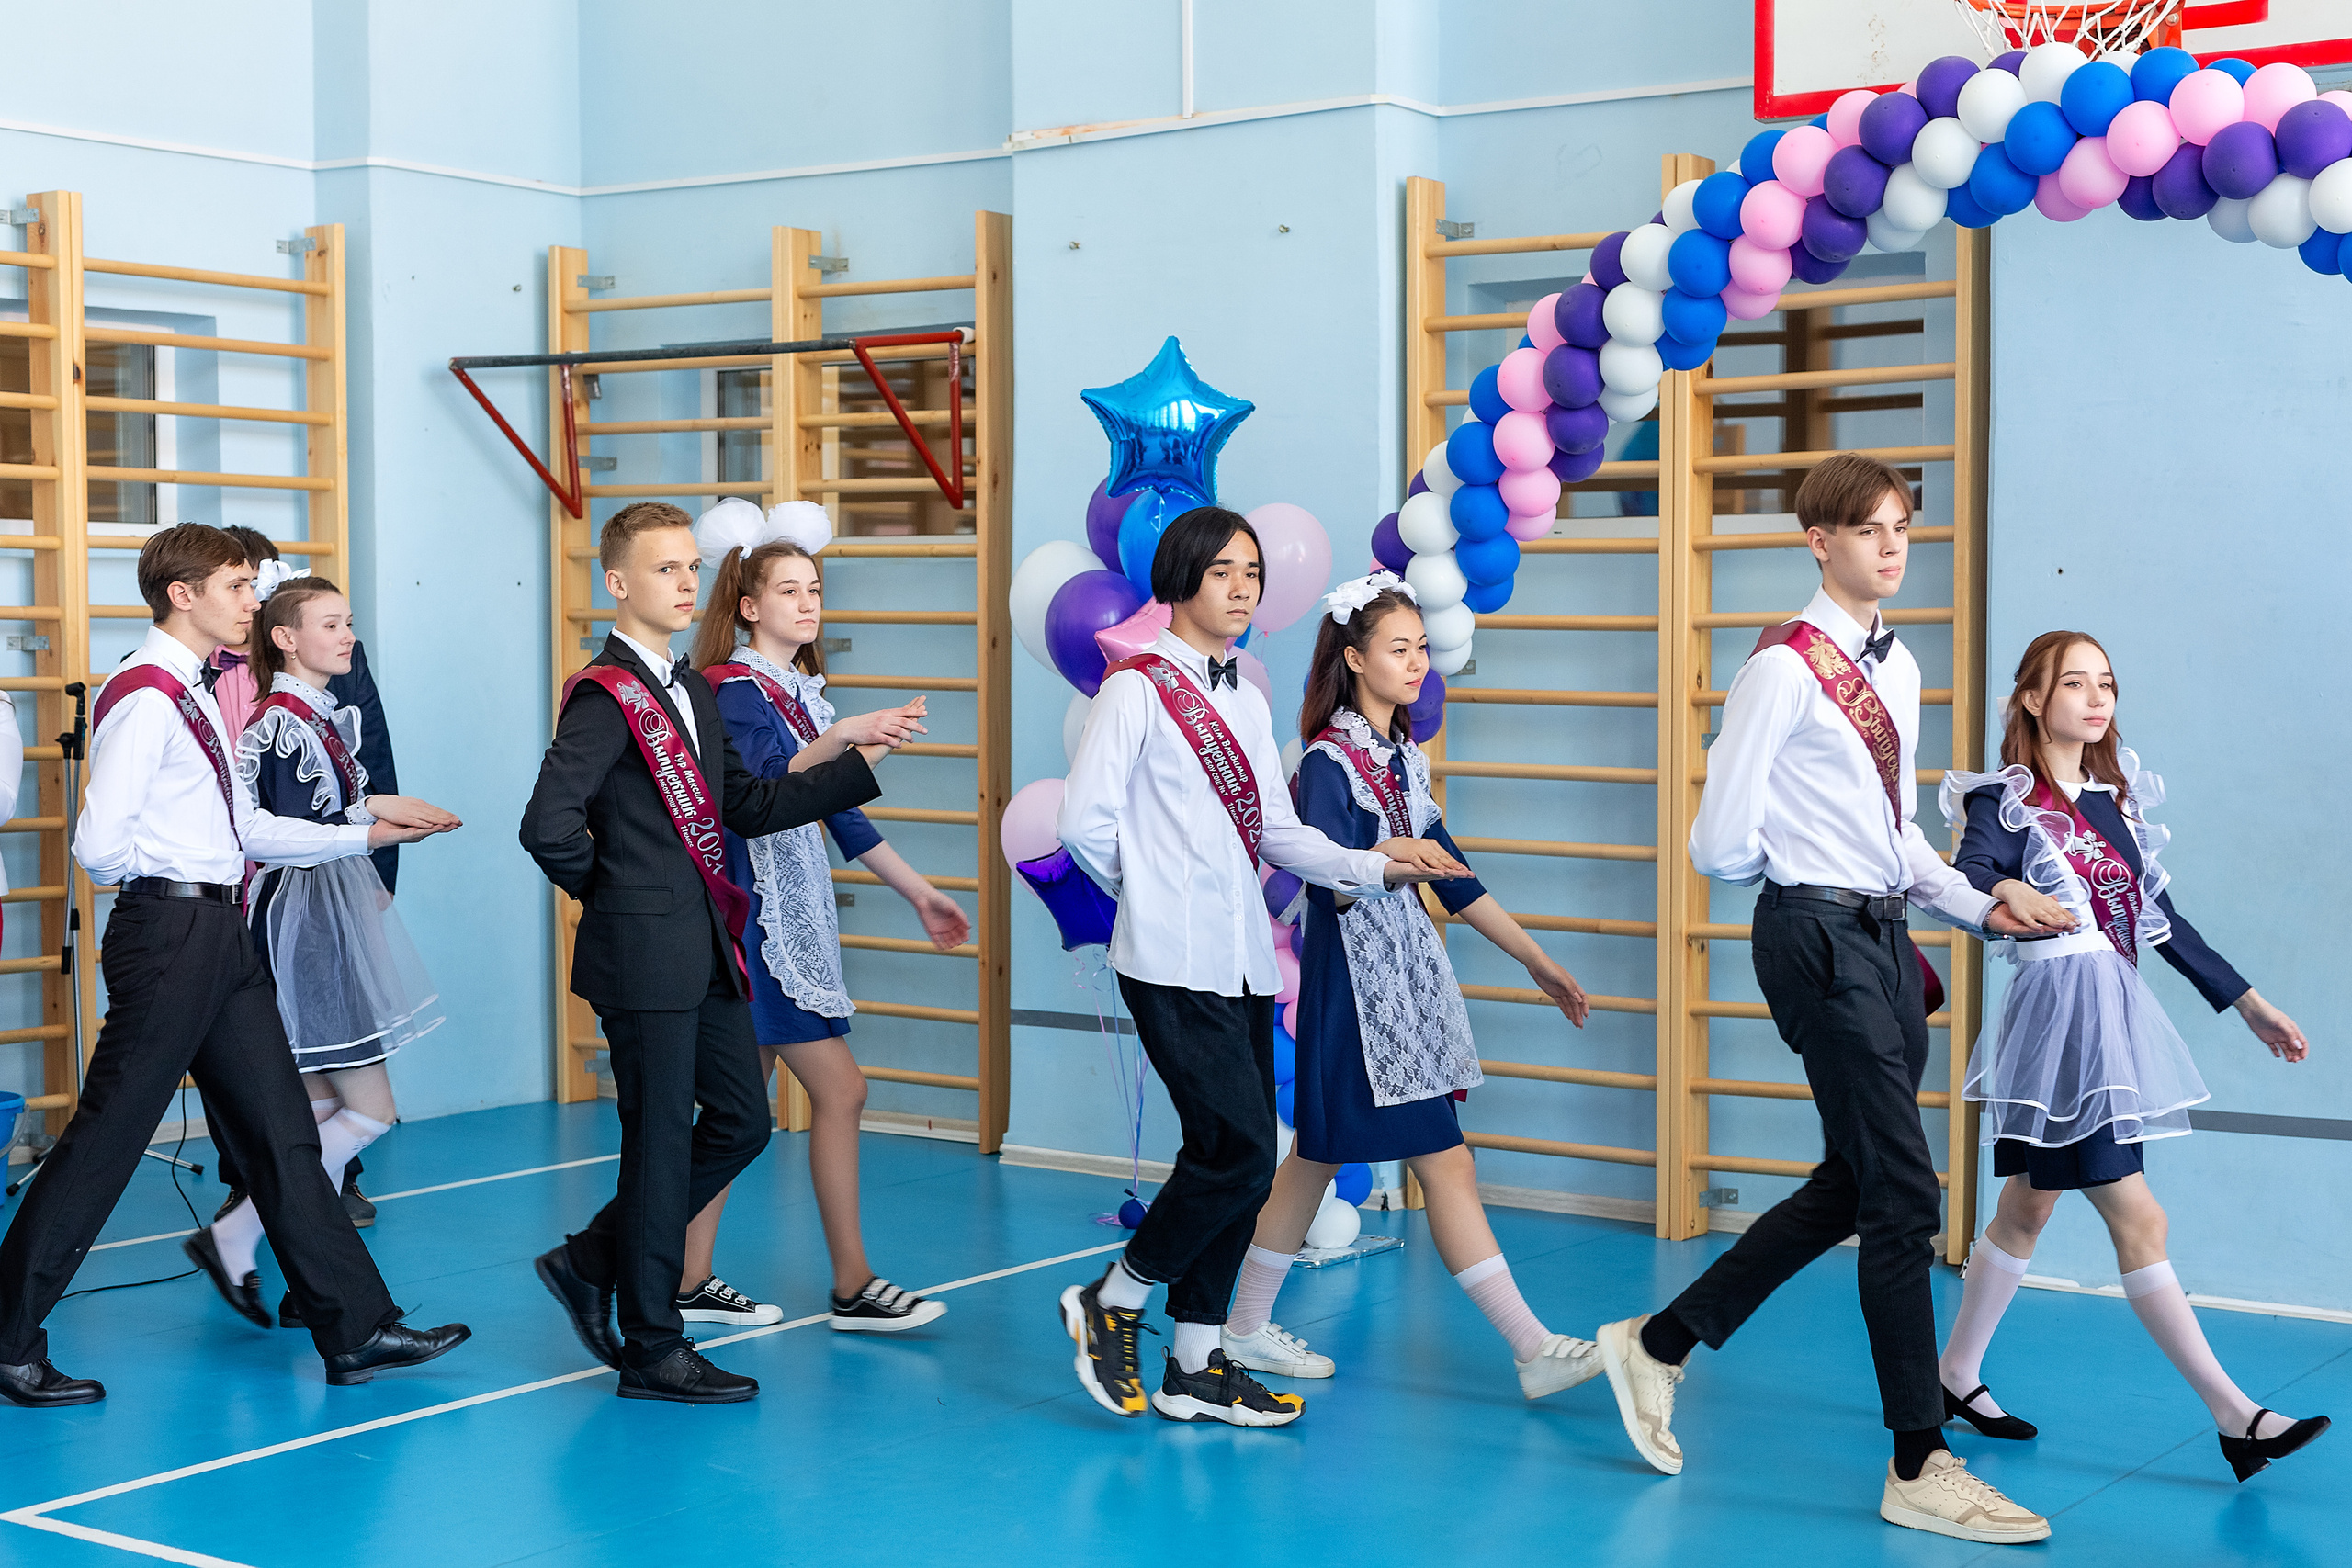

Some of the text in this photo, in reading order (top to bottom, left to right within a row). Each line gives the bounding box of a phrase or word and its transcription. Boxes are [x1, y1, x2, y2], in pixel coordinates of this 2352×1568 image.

[639, 708, 698, 820] Выпускник
[674, 751, 706, 805] Тур Максим
[1172, 688, 1242, 796] Выпускник
[1208, 720, 1250, 784] Ким Владимир
